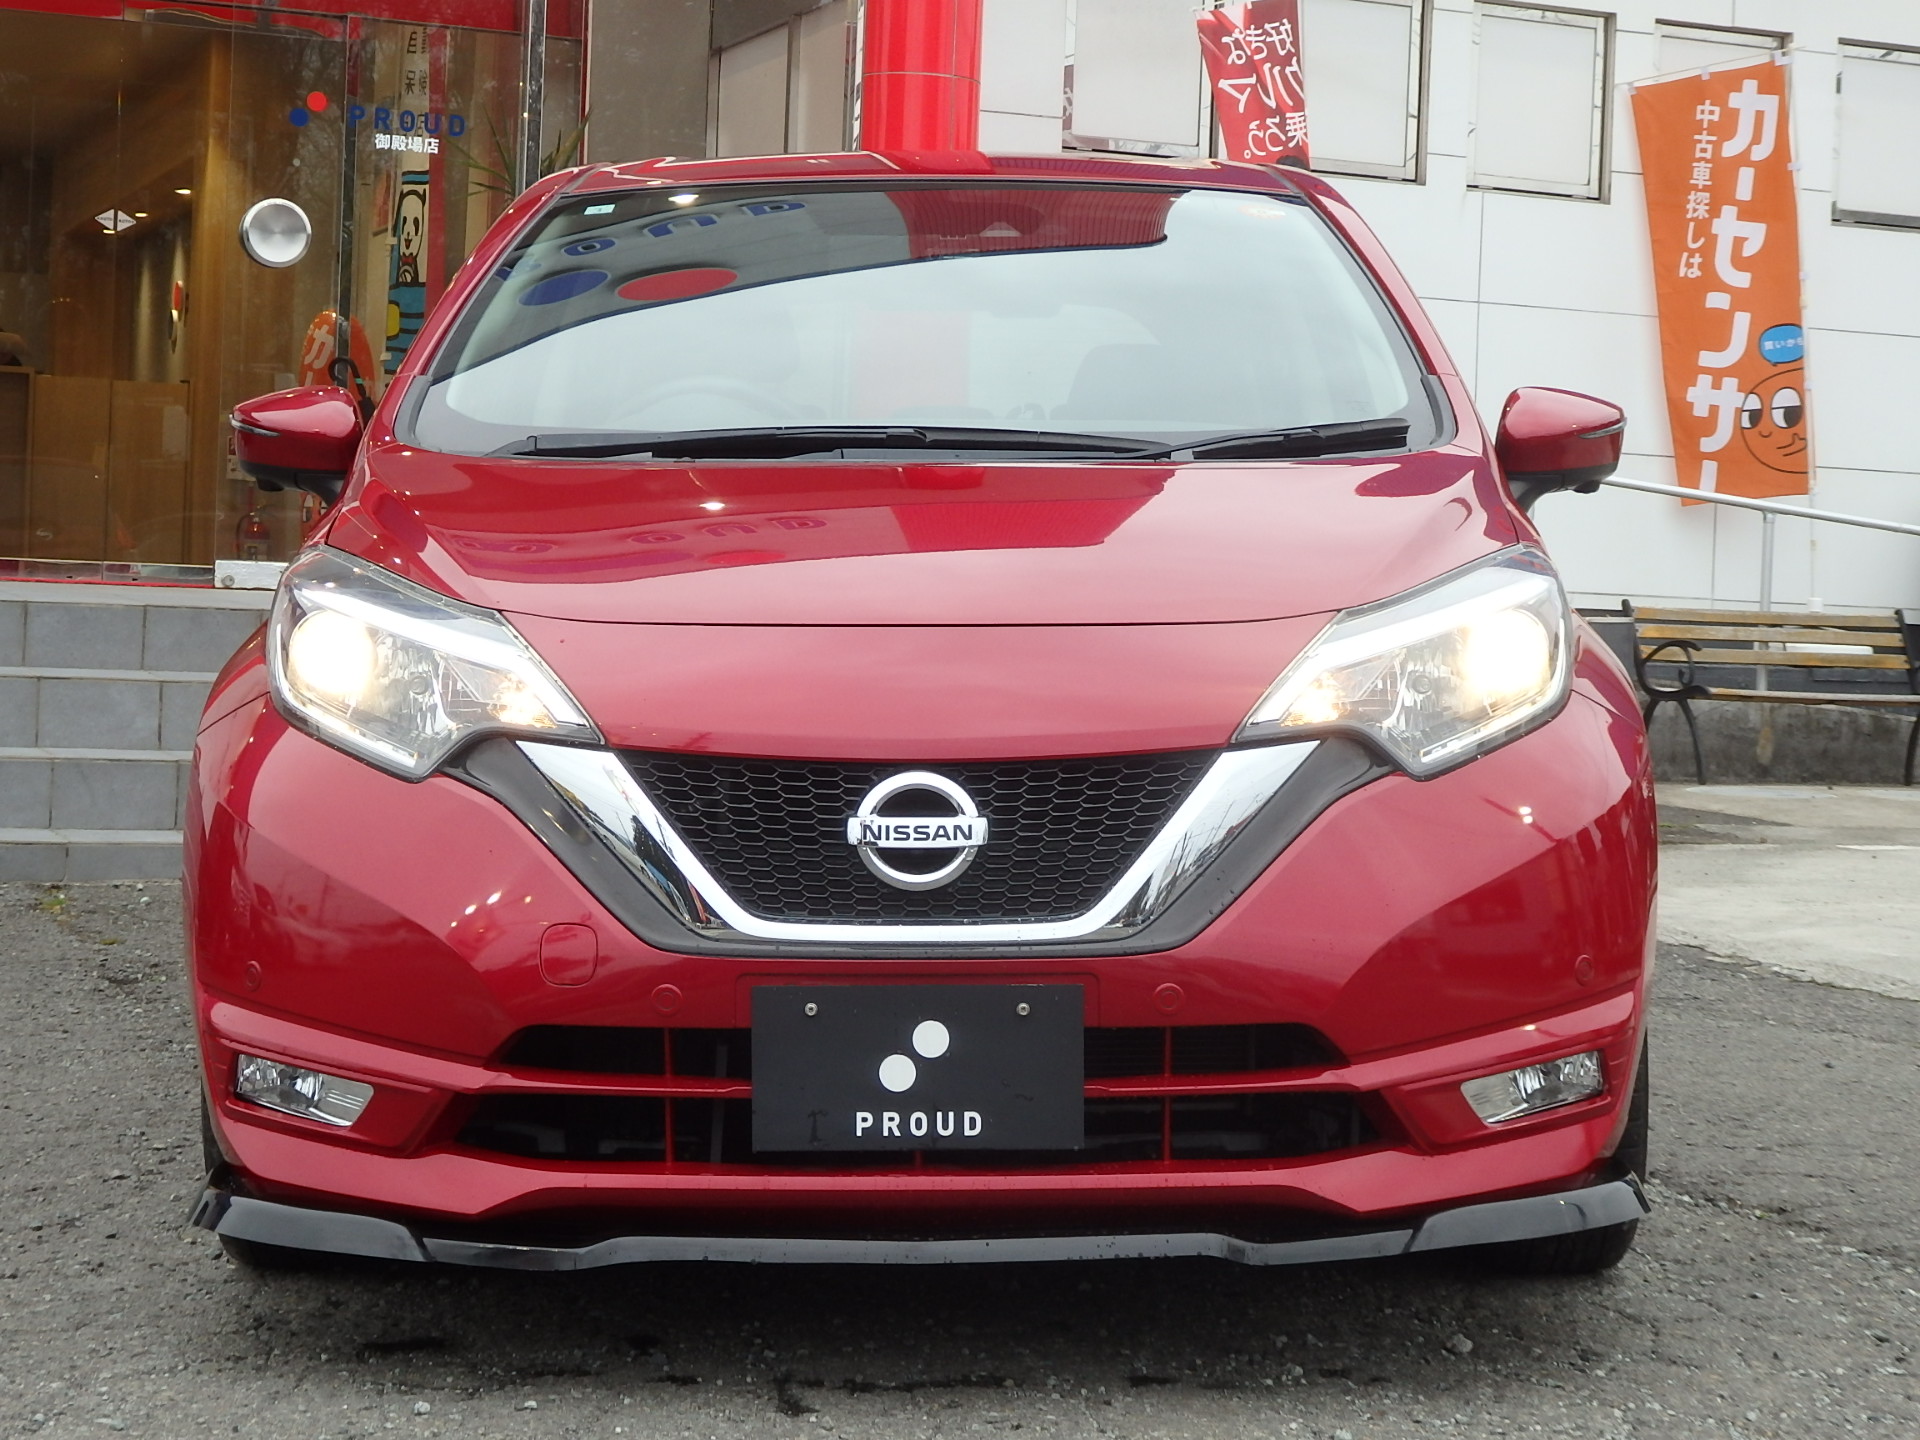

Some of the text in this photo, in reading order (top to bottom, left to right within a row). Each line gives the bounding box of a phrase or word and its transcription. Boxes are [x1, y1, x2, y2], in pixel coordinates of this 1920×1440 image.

[347, 105, 467, 137] PROUD
[375, 133, 440, 154] 御殿場店
[1679, 99, 1720, 279] 中古車探しは
[1686, 79, 1780, 493] カーセンサー
[862, 824, 973, 842] NISSAN
[855, 1111, 983, 1137] PROUD
